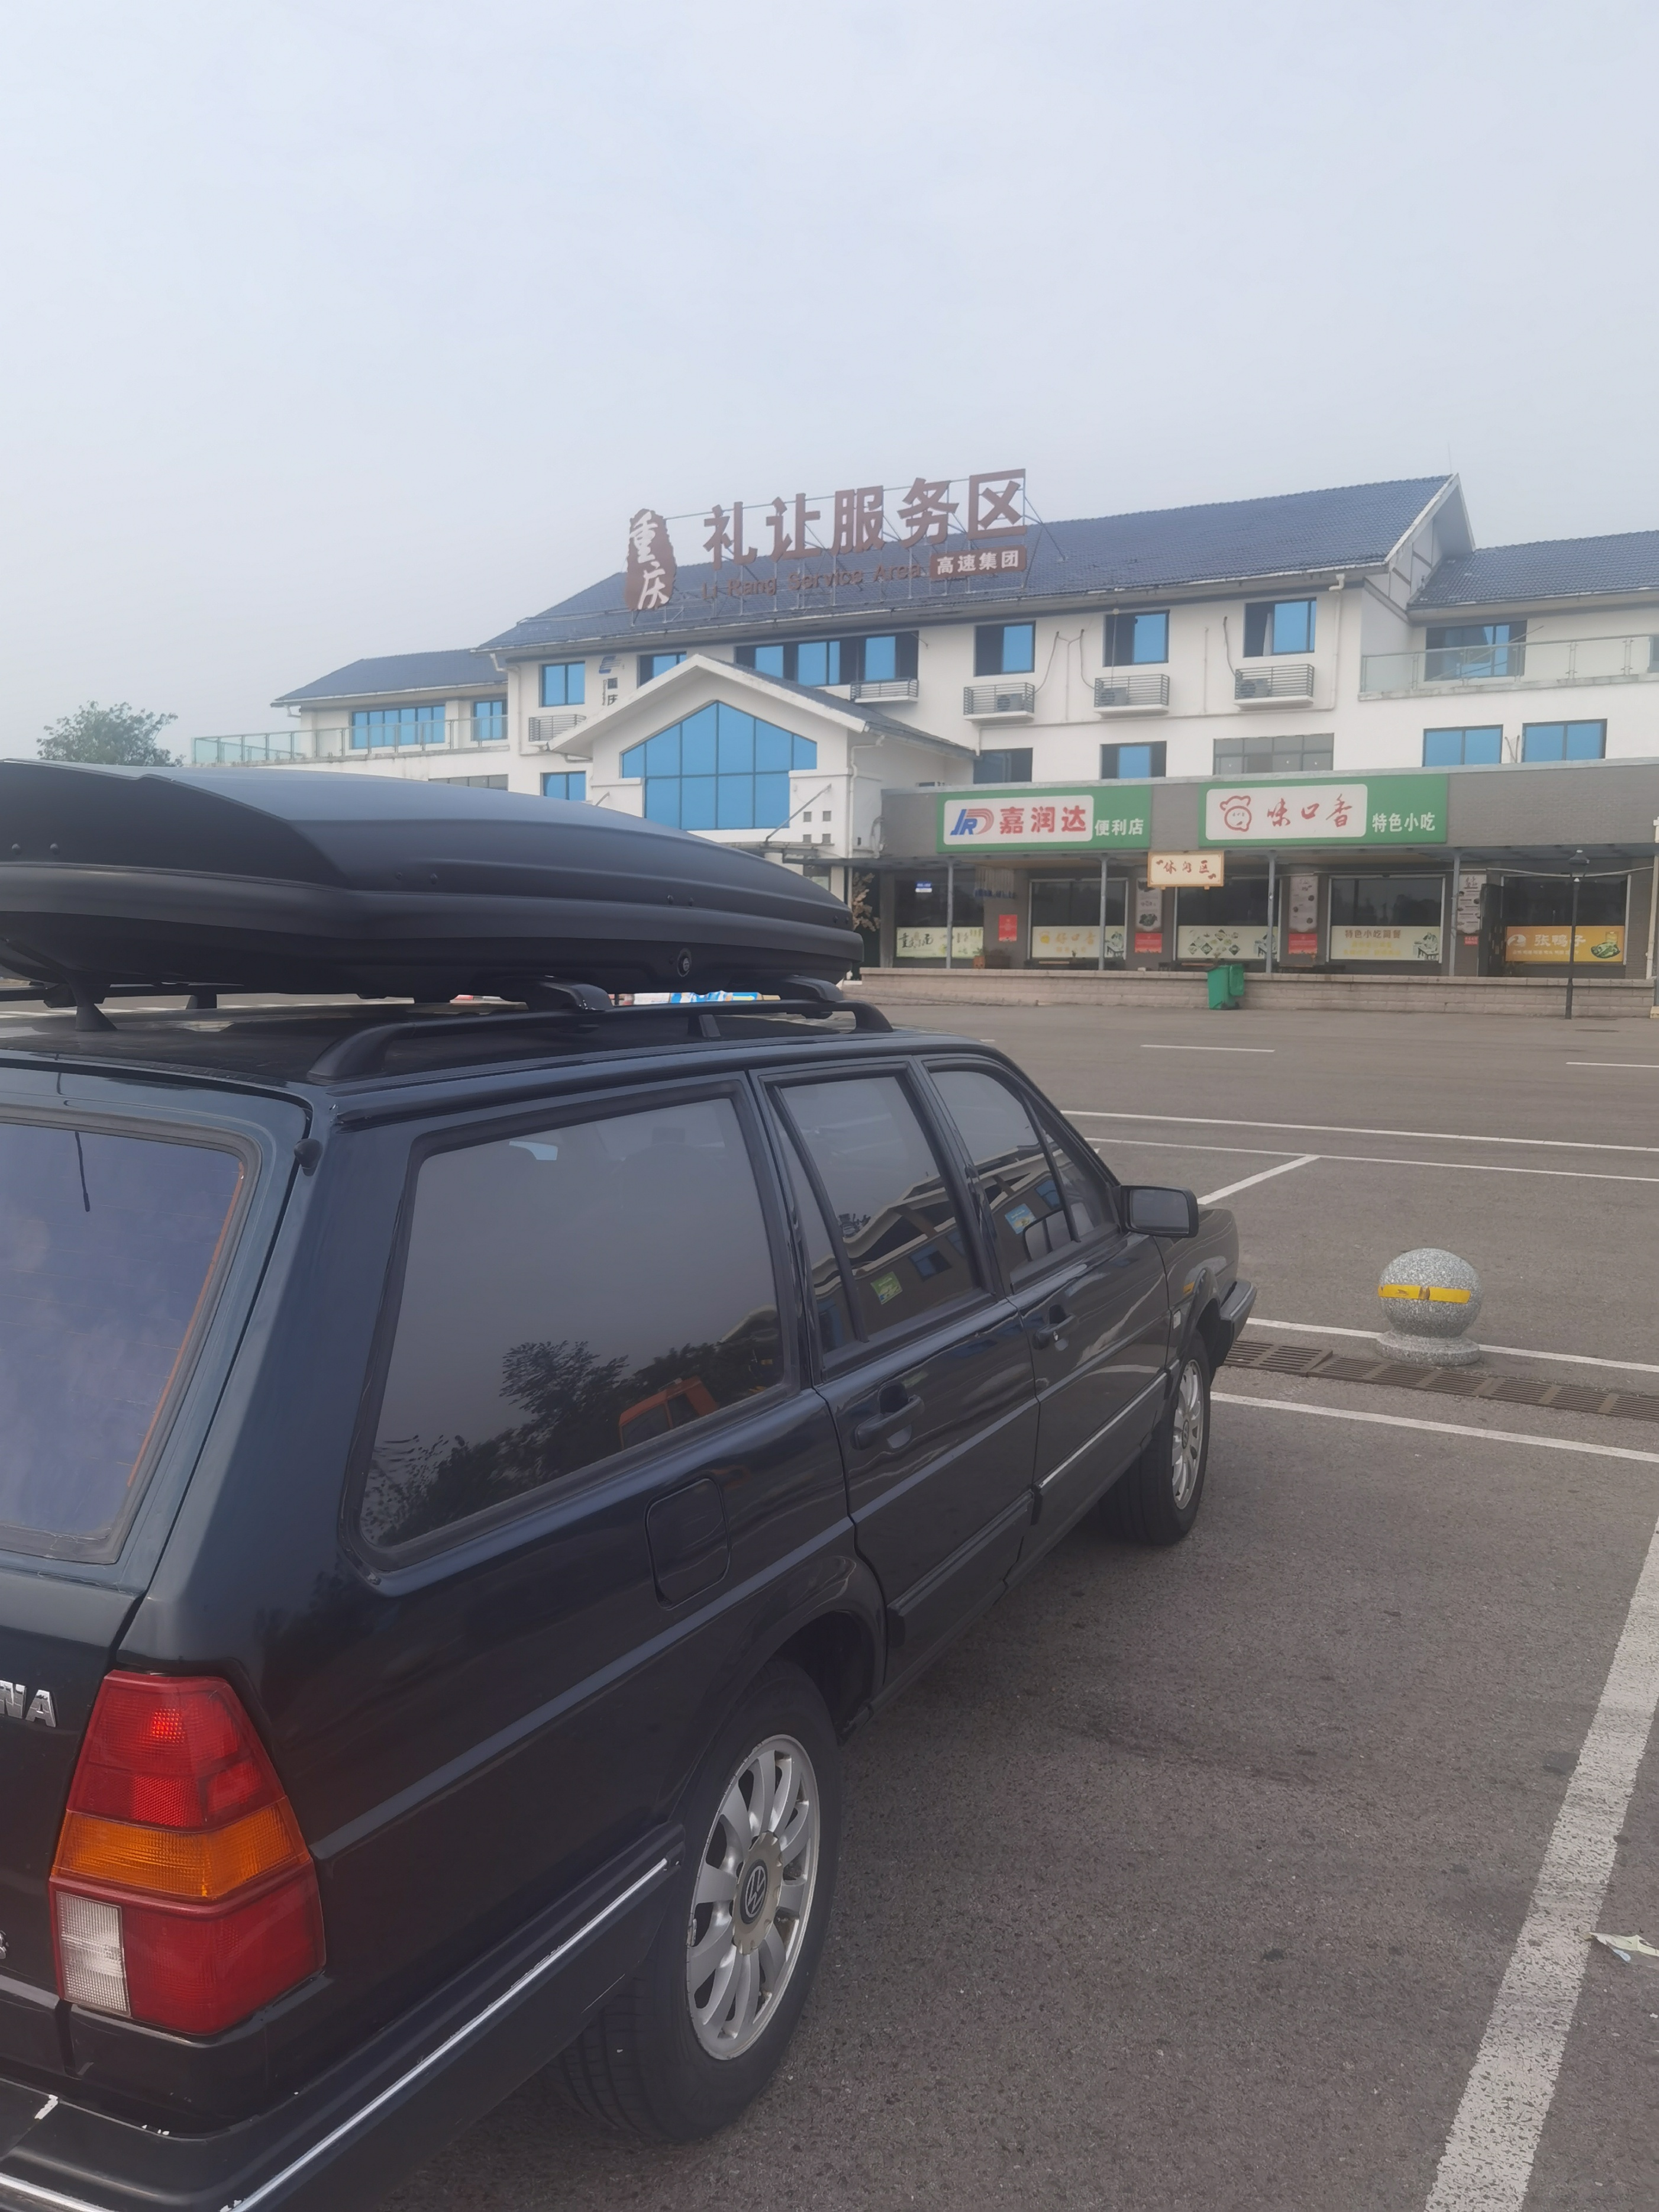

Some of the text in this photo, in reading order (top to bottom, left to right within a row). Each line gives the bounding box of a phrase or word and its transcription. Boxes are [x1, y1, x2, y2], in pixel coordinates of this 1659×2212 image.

[703, 468, 1027, 570] 礼让服务区
[630, 511, 669, 610] 重庆
[936, 550, 1019, 575] 高速集团
[702, 563, 923, 599] Li Rang Service Area
[999, 805, 1087, 835] 嘉润达
[1267, 794, 1353, 828] 味口香
[1372, 812, 1435, 833] 特色小吃
[1095, 818, 1144, 837] 便利店
[1535, 934, 1586, 947] 张鸭子
